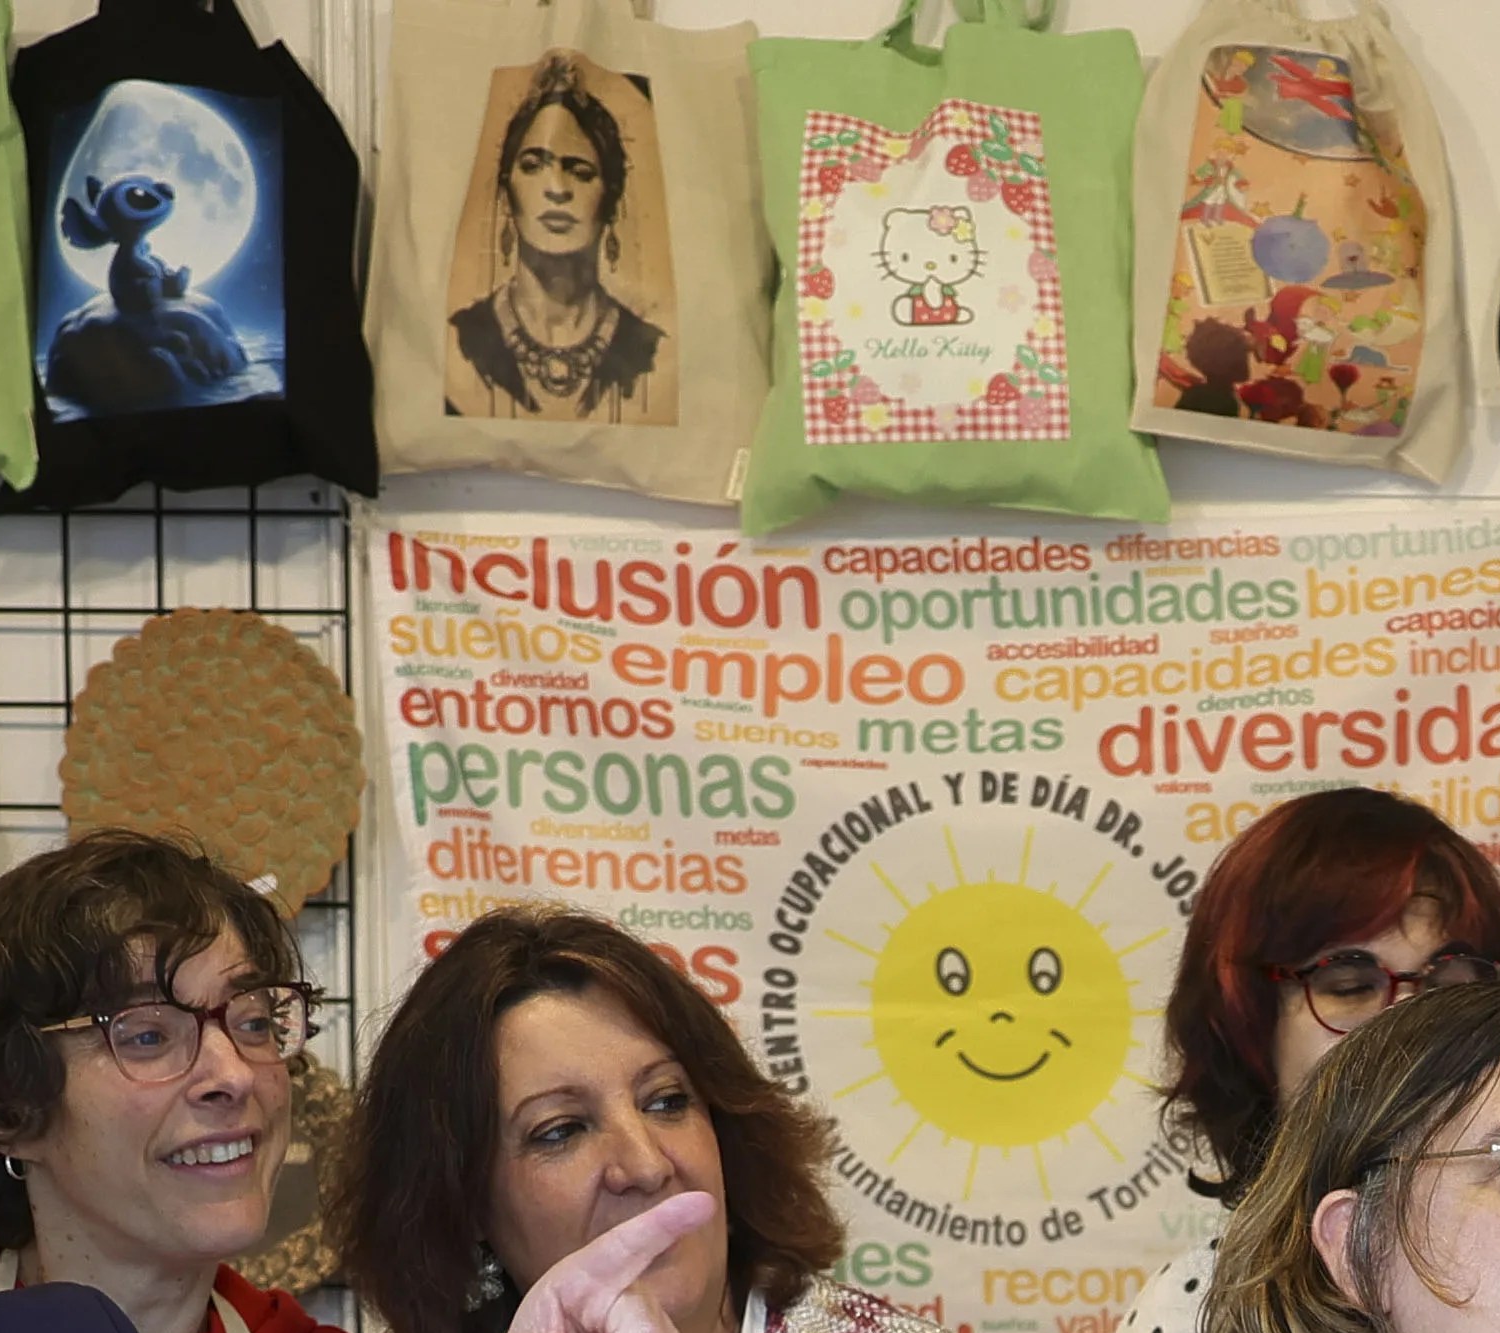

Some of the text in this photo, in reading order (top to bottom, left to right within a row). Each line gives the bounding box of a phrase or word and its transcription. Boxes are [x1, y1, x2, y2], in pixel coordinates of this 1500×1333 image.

[863, 335, 992, 365] Hello Kitty
[823, 536, 1092, 583] capacidades
[1104, 529, 1281, 562] diferencias
[840, 566, 1299, 645] oportunidades
[389, 606, 602, 664] sueños
[986, 632, 1160, 662] accesibilidad
[1209, 622, 1300, 647] sueños
[490, 668, 589, 691] diversidad
[611, 633, 965, 719] empleo
[994, 634, 1397, 712] capacidades
[400, 680, 676, 740] entornos
[1197, 685, 1315, 714] derechos
[693, 718, 842, 751] sueños
[857, 707, 1066, 755] metas
[408, 740, 797, 827] personas
[942, 772, 965, 806] Y
[979, 770, 1022, 805] DE
[1030, 773, 1092, 823] DÍA
[530, 815, 652, 843] diversidad
[713, 825, 783, 849] metas
[1093, 800, 1146, 859] DR.
[426, 827, 749, 895] diferencias
[769, 781, 935, 956] OCUPACIONAL
[1152, 854, 1201, 920] JOS
[619, 904, 754, 932] derechos
[761, 968, 811, 1097] CENTRO
[824, 1117, 1196, 1248] yuntamiento de Torrijo
